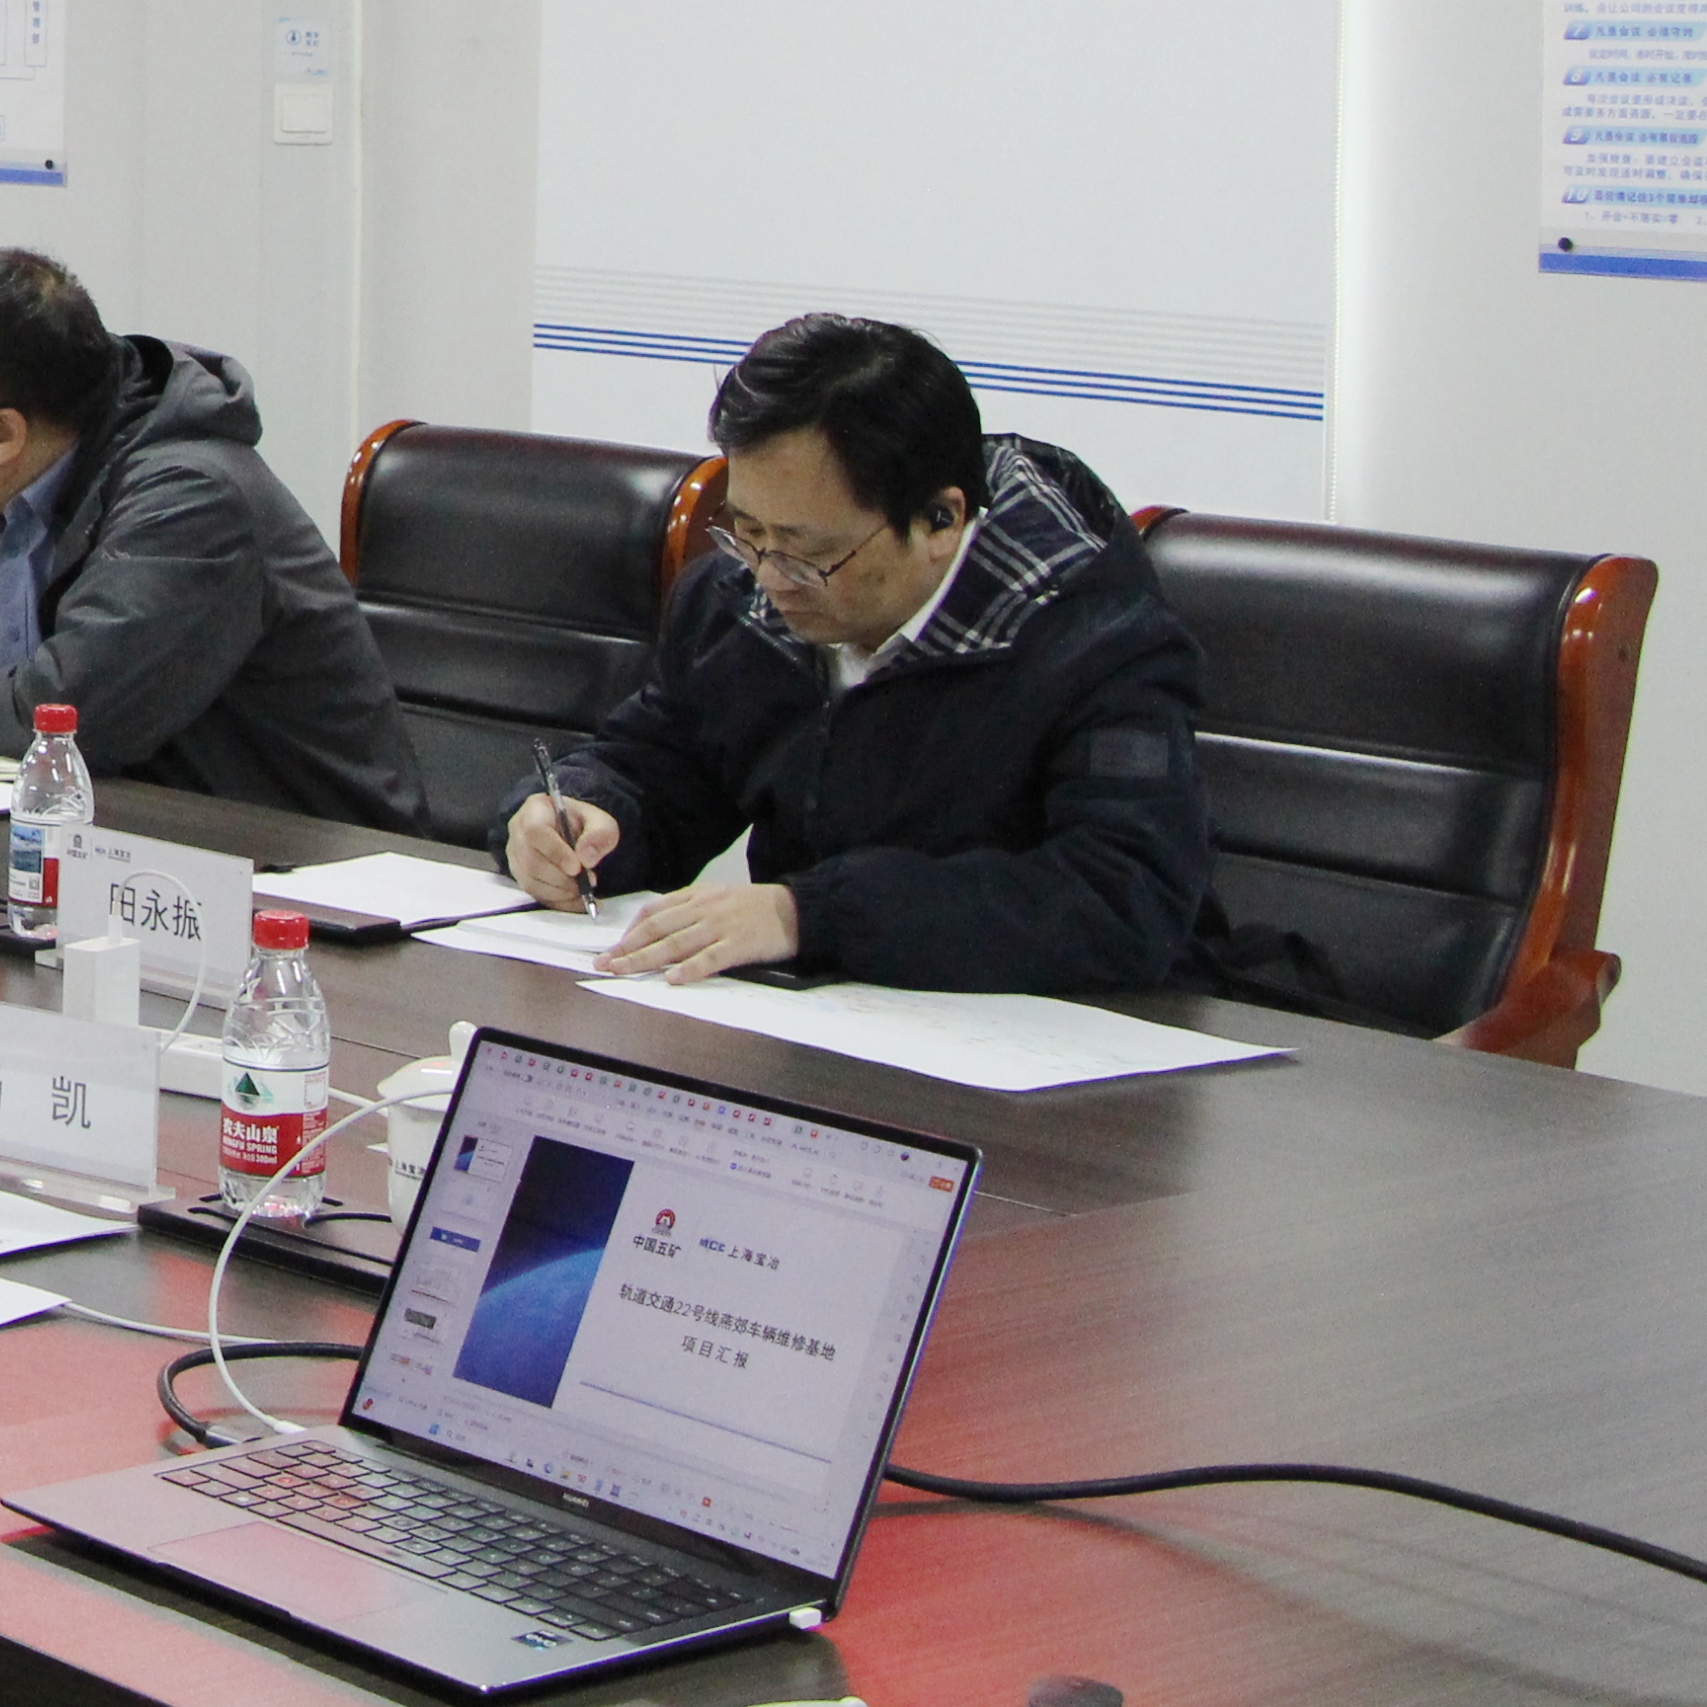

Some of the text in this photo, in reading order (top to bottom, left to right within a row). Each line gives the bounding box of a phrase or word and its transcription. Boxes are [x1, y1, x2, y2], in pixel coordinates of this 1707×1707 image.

[223, 1117, 278, 1144] 农夫山泉
[247, 1143, 278, 1155] SPRING
[633, 1234, 682, 1259] 中国五矿
[727, 1245, 780, 1271] 上海宝冶
[619, 1283, 837, 1362] 轨道交通22号线燕郊车辆维修基地
[681, 1335, 750, 1369] 项目汇报
